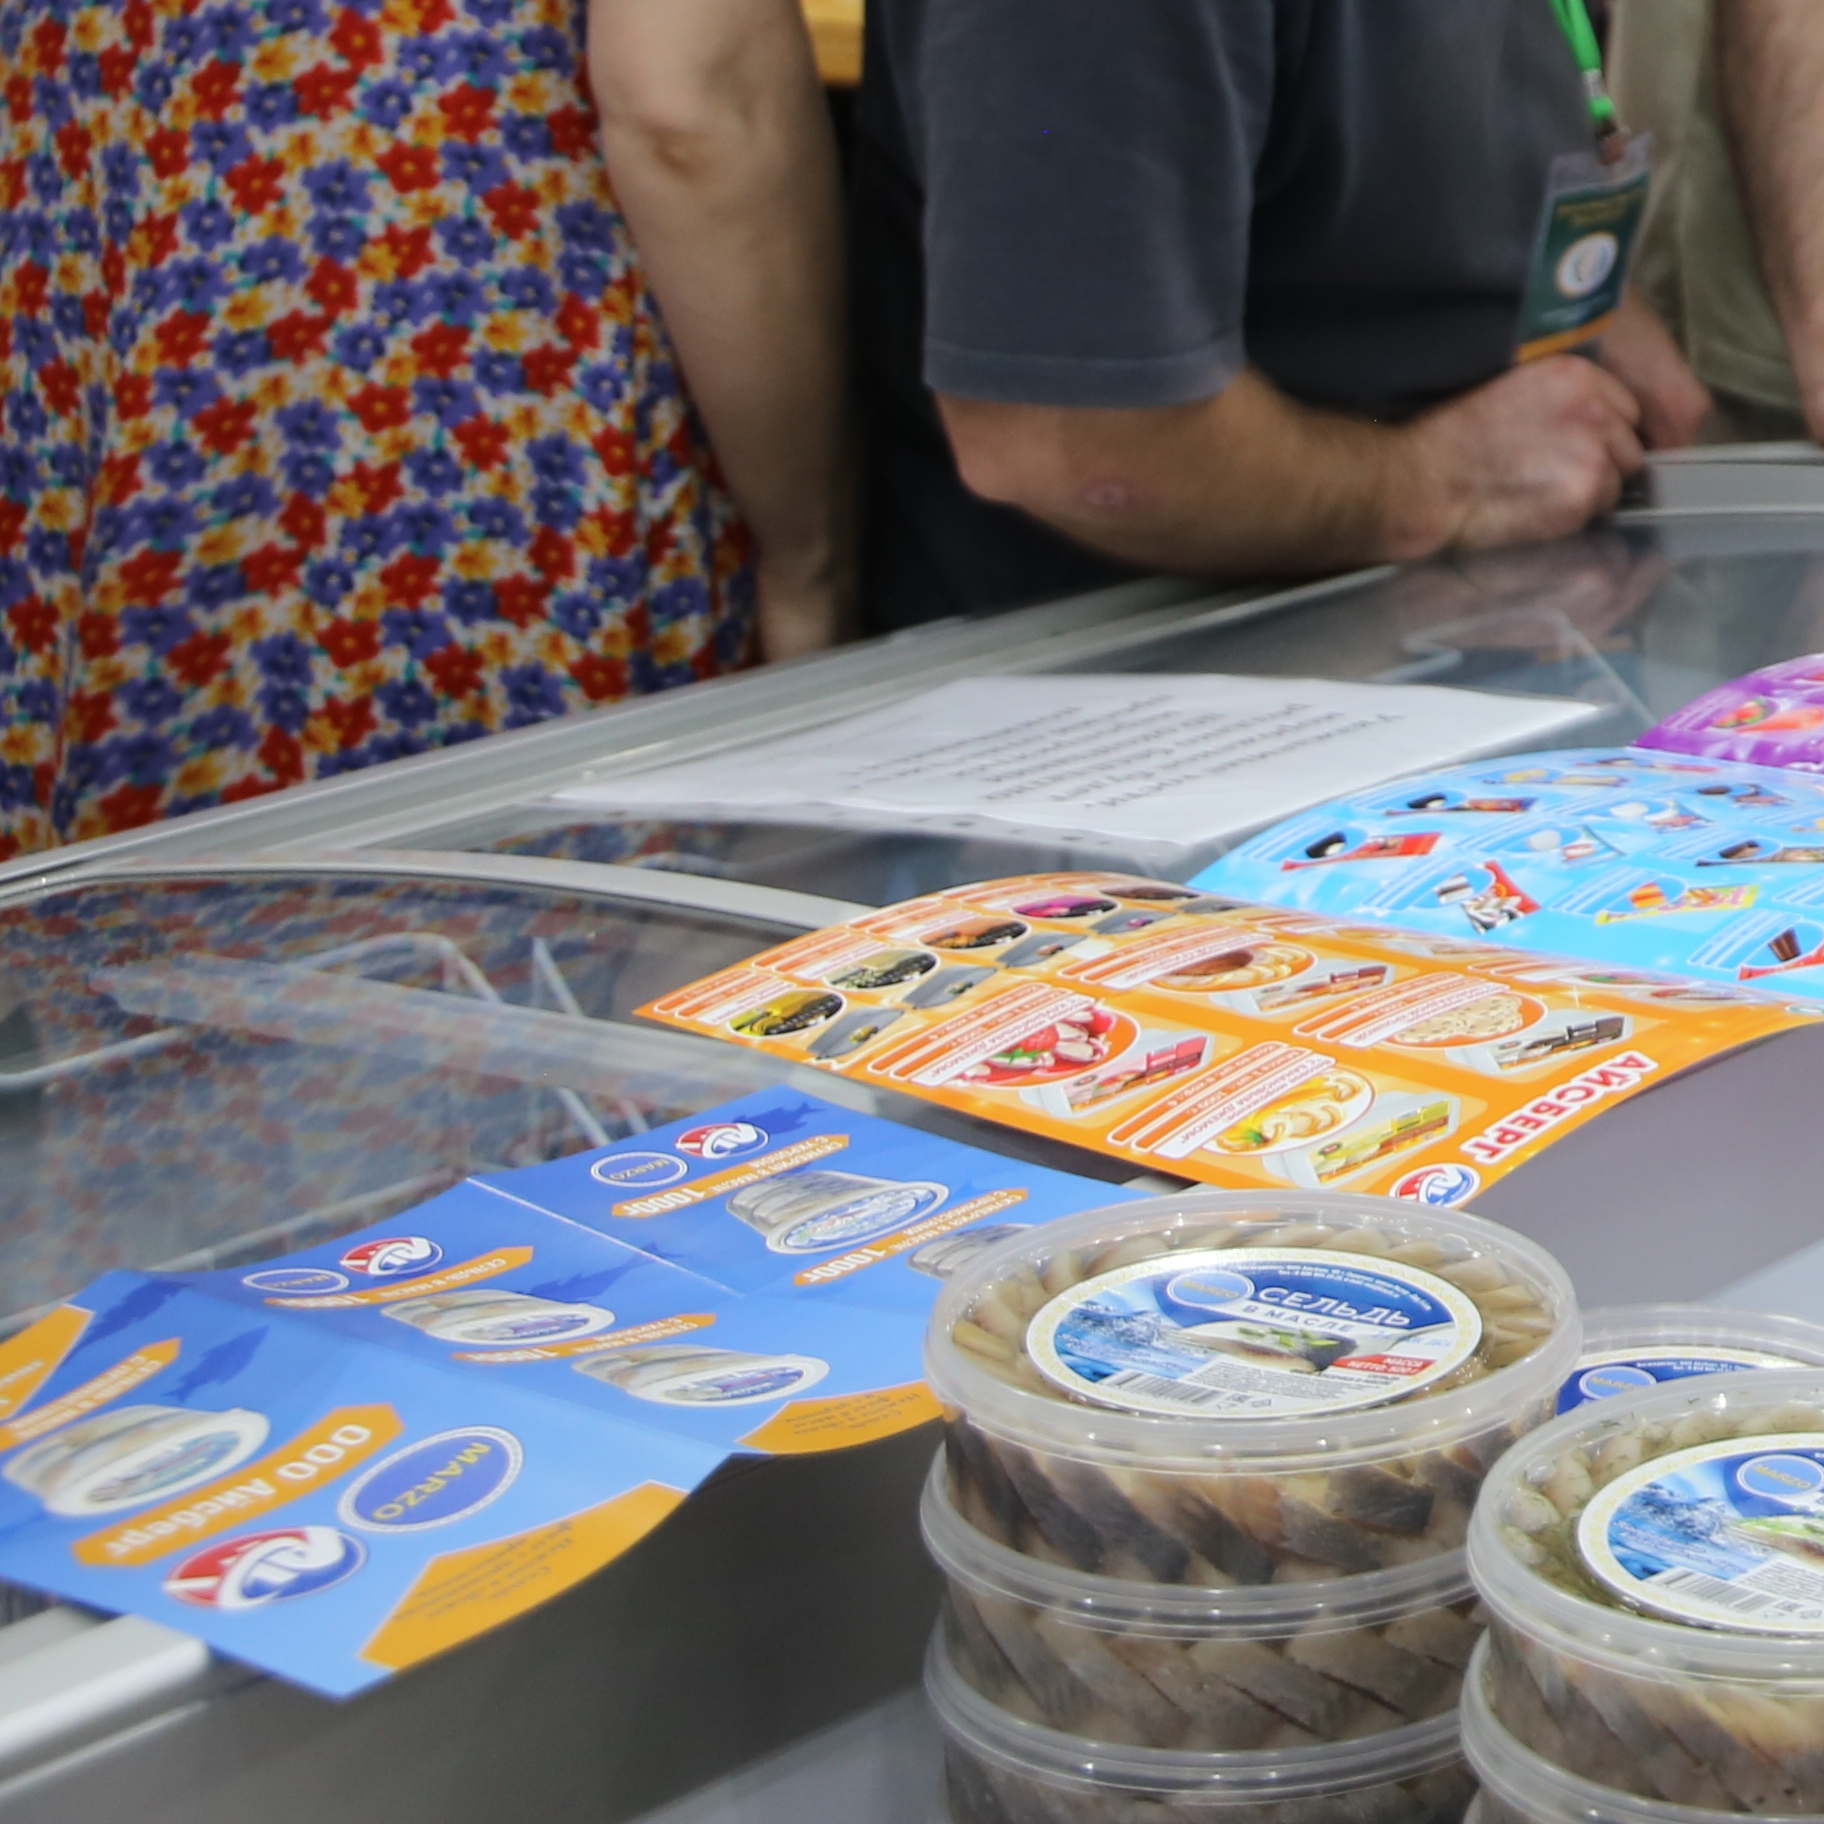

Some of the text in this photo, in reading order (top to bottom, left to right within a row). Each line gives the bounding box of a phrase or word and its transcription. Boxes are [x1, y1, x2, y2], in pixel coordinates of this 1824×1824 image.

[1459, 1052, 1661, 1166] АЙСБЕРГ
[1242, 1304, 1356, 1333] В МАСЛЕ
[1257, 1285, 1412, 1328] СЕЛЬДЬ
[100, 1422, 374, 1562] ООО Айсберг
[370, 1438, 493, 1524] MARZO
